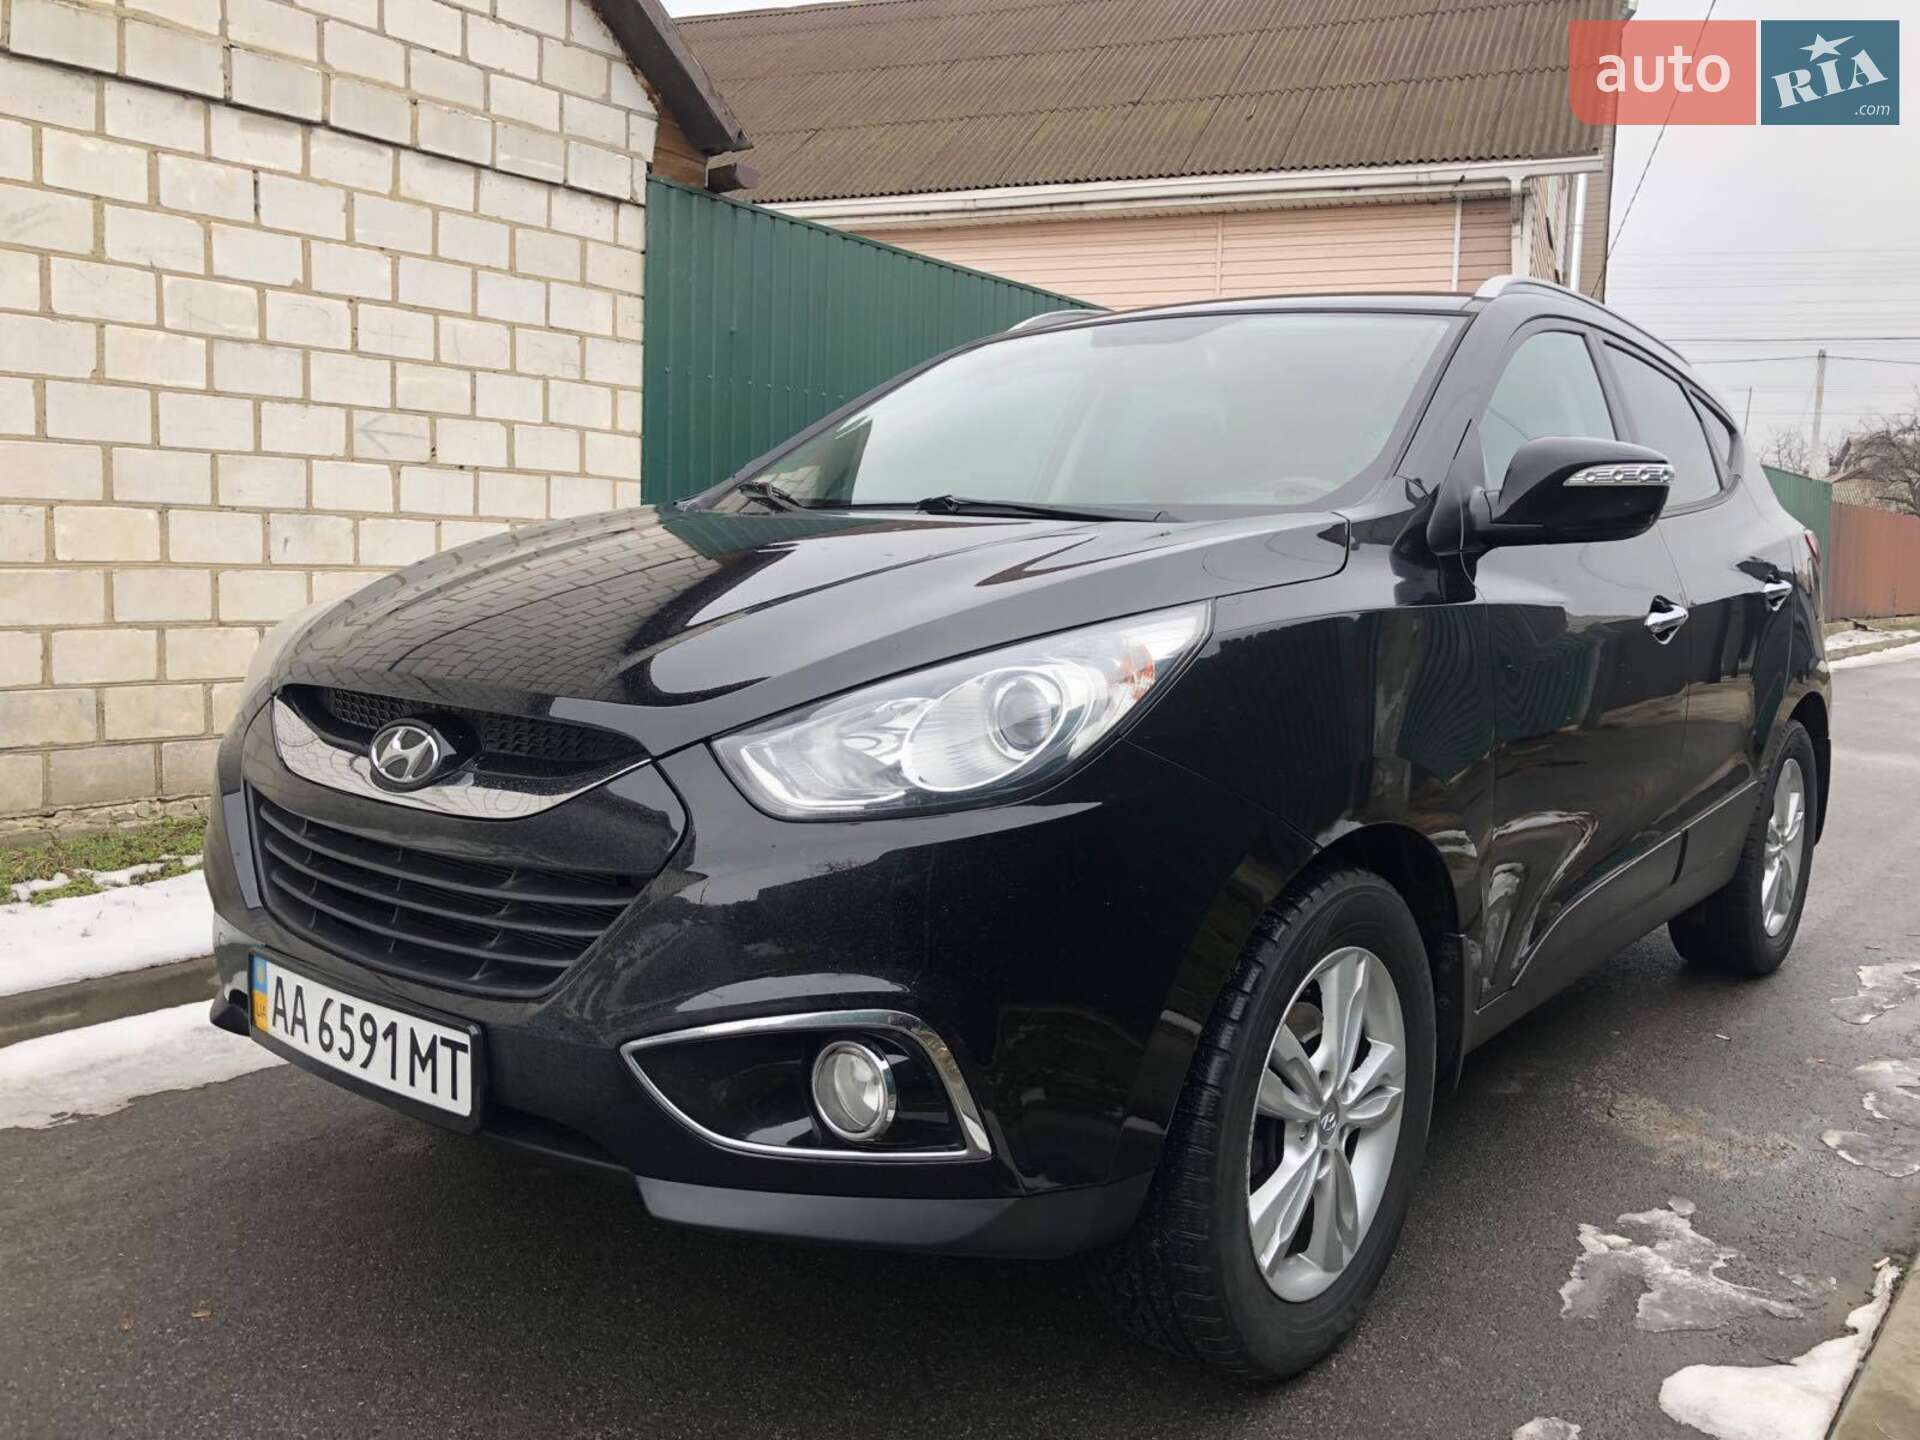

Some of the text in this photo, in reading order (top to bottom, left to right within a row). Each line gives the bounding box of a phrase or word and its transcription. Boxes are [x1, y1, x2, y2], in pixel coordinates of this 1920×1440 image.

[272, 976, 469, 1102] AA 6591 MT
